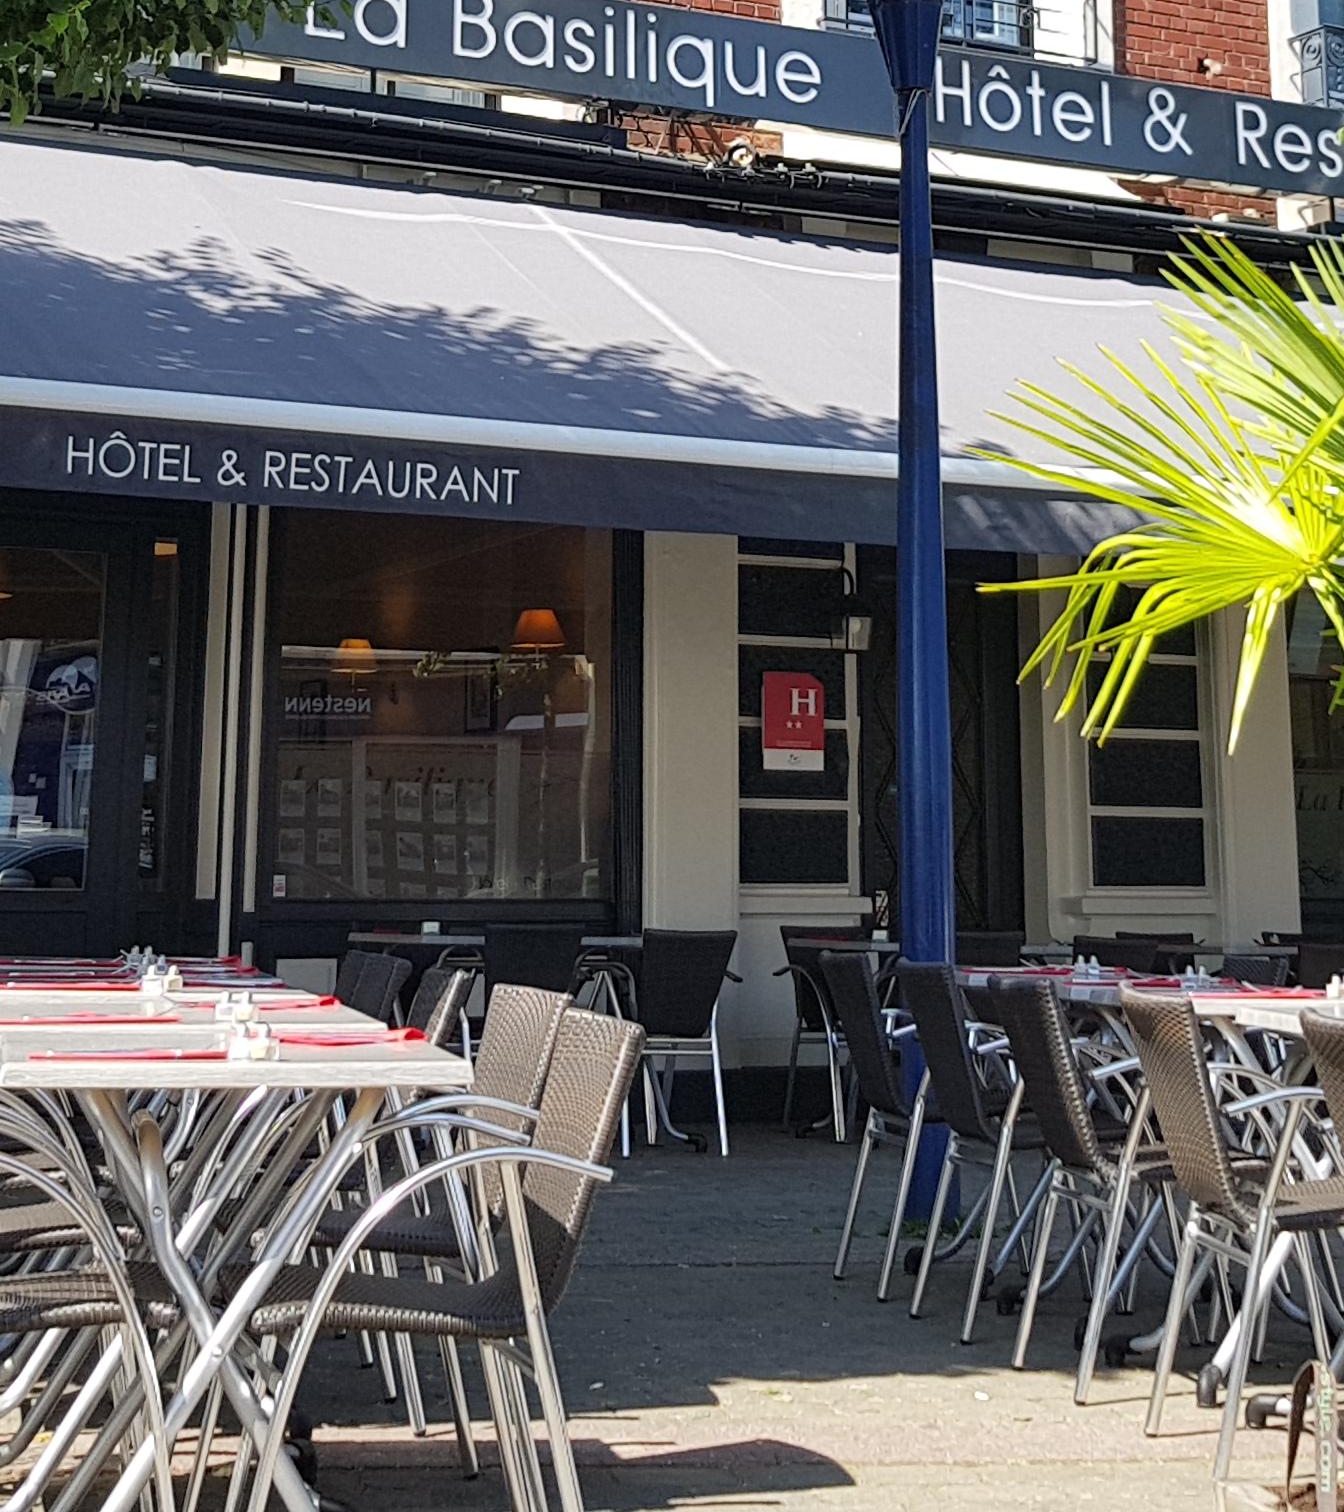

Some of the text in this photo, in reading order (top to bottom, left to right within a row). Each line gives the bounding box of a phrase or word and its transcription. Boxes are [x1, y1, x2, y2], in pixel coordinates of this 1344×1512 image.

[935, 56, 1113, 147] Hôtel
[1144, 87, 1195, 157] &
[66, 430, 521, 506] HÔTEL & RESTAURANT
[790, 688, 818, 717] H
